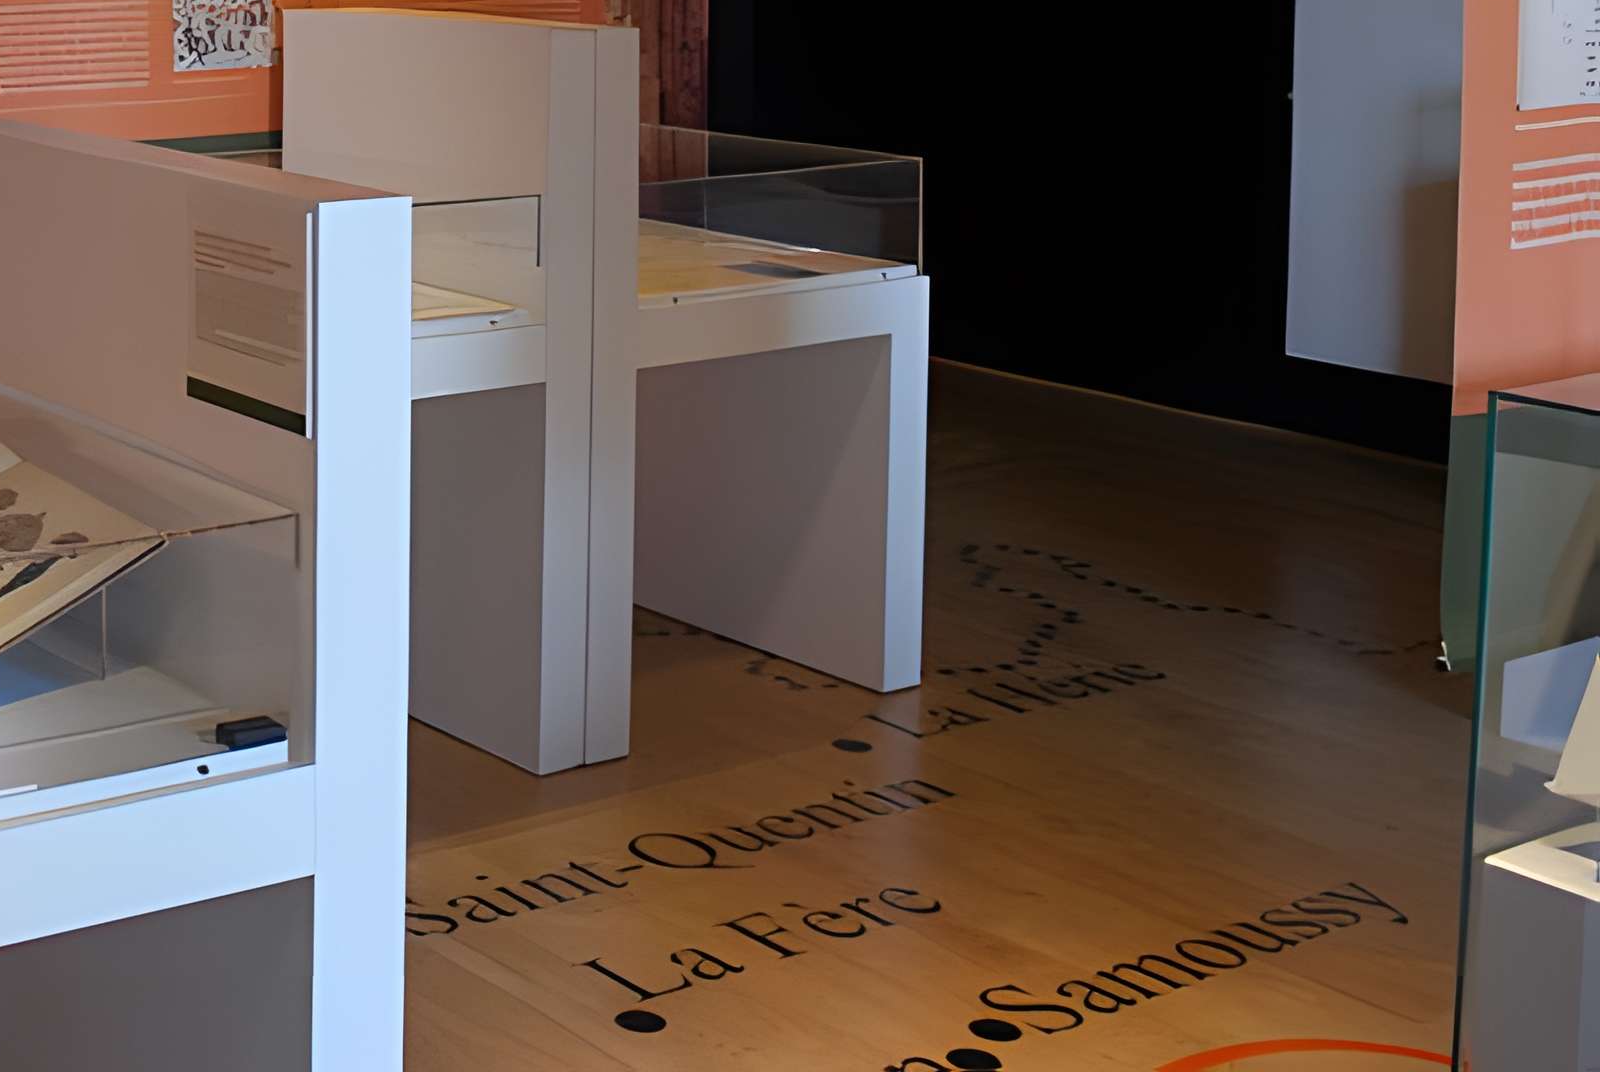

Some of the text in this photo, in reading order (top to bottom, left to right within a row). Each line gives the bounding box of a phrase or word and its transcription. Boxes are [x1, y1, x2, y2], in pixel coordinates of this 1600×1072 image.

[866, 701, 991, 740] La
[405, 778, 959, 937] Saint-Quentin
[574, 885, 943, 1003] La Fère
[979, 881, 1410, 1035] Samoussy
